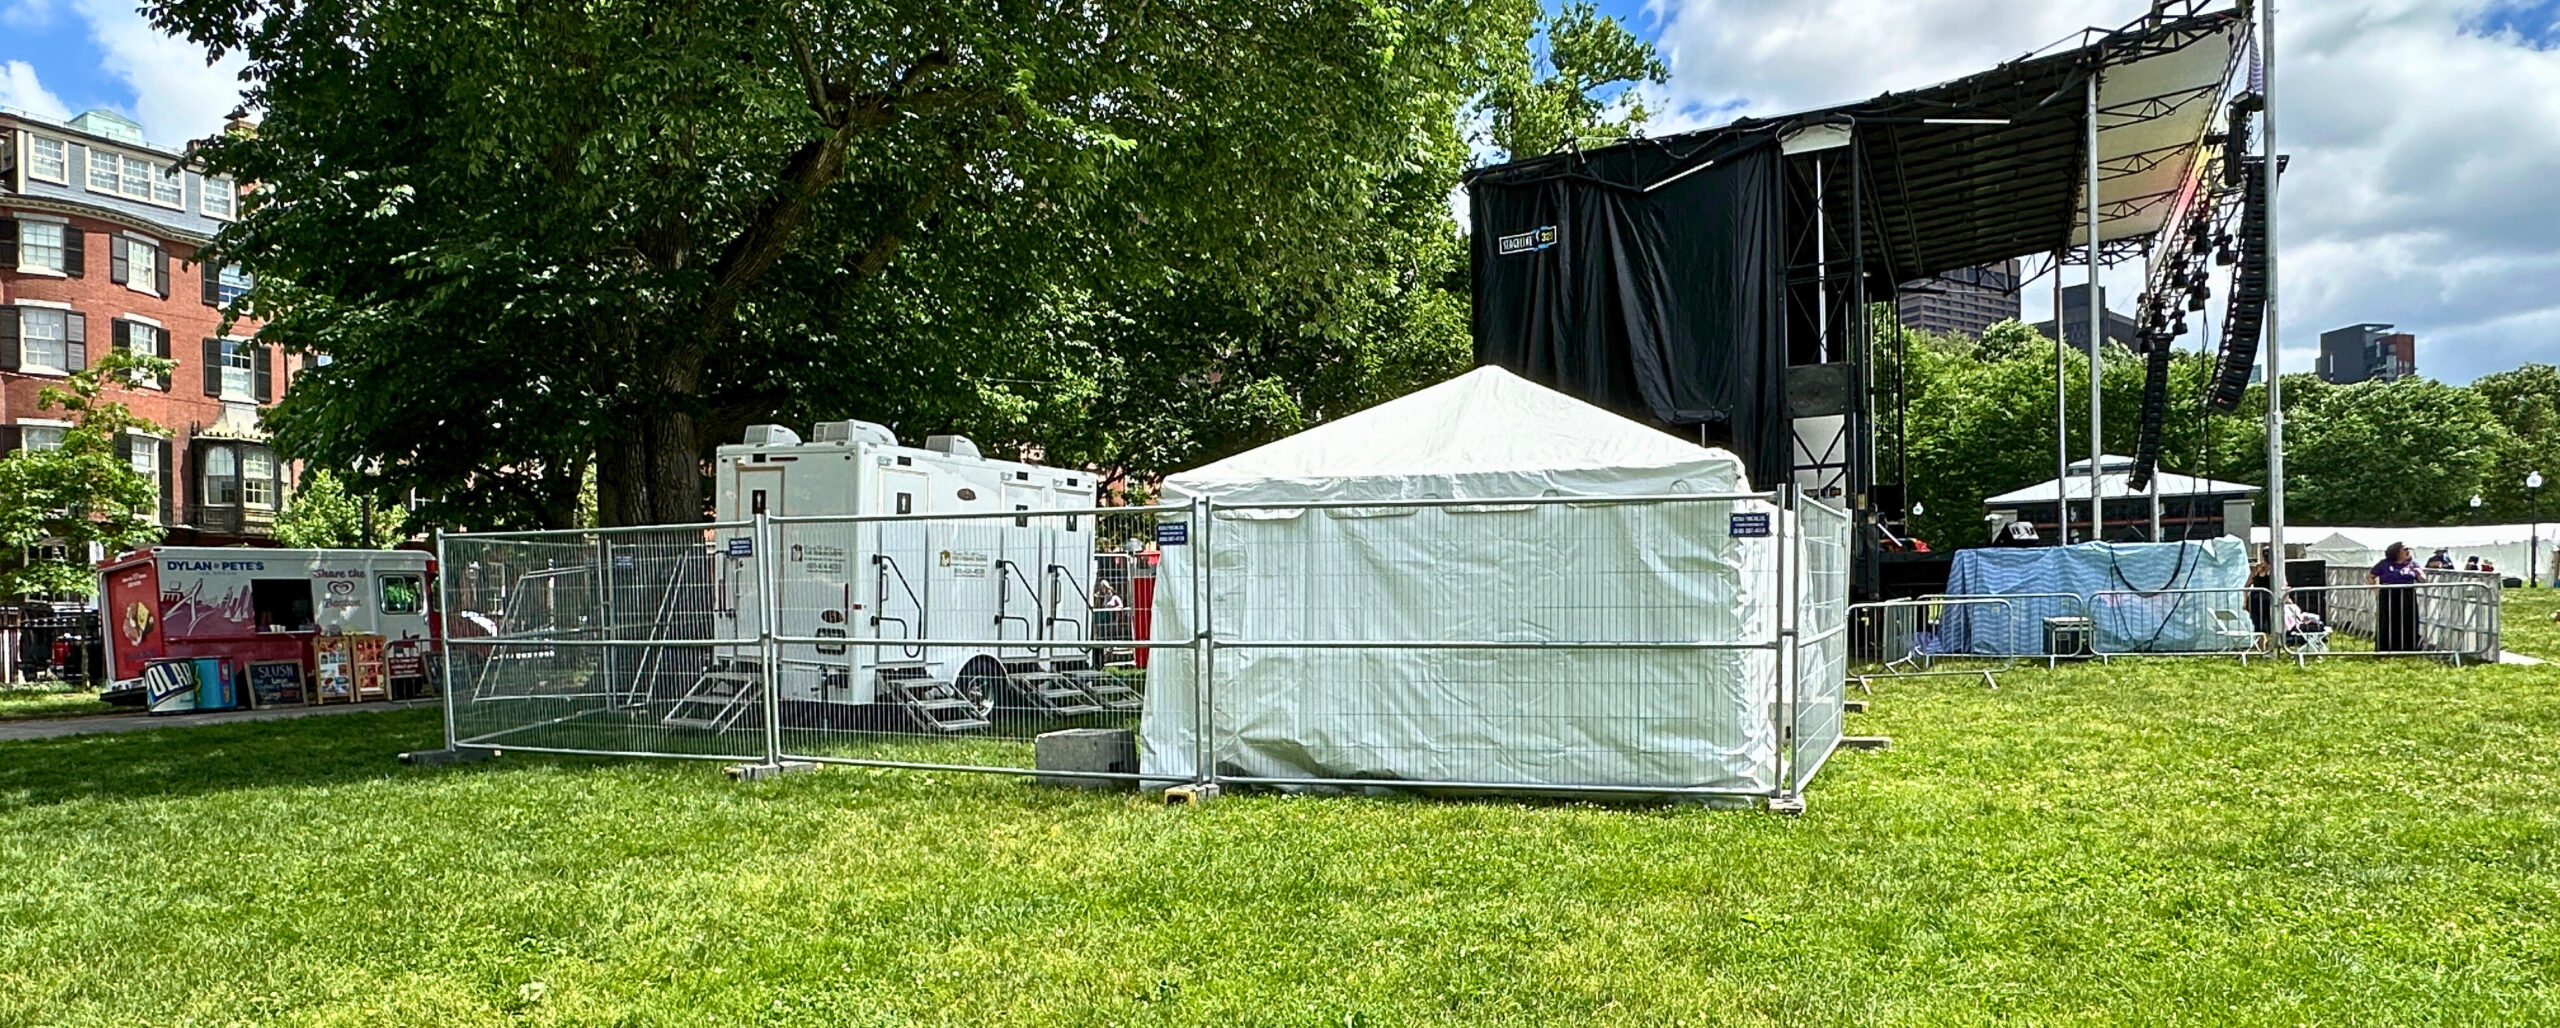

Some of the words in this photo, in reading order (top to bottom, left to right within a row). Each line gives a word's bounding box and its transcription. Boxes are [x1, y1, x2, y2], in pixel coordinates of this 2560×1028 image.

[167, 561, 213, 571] DYLAN
[221, 561, 265, 571] PETE'S
[313, 568, 346, 578] Share
[348, 568, 366, 578] the
[258, 664, 294, 679] SLUSH
